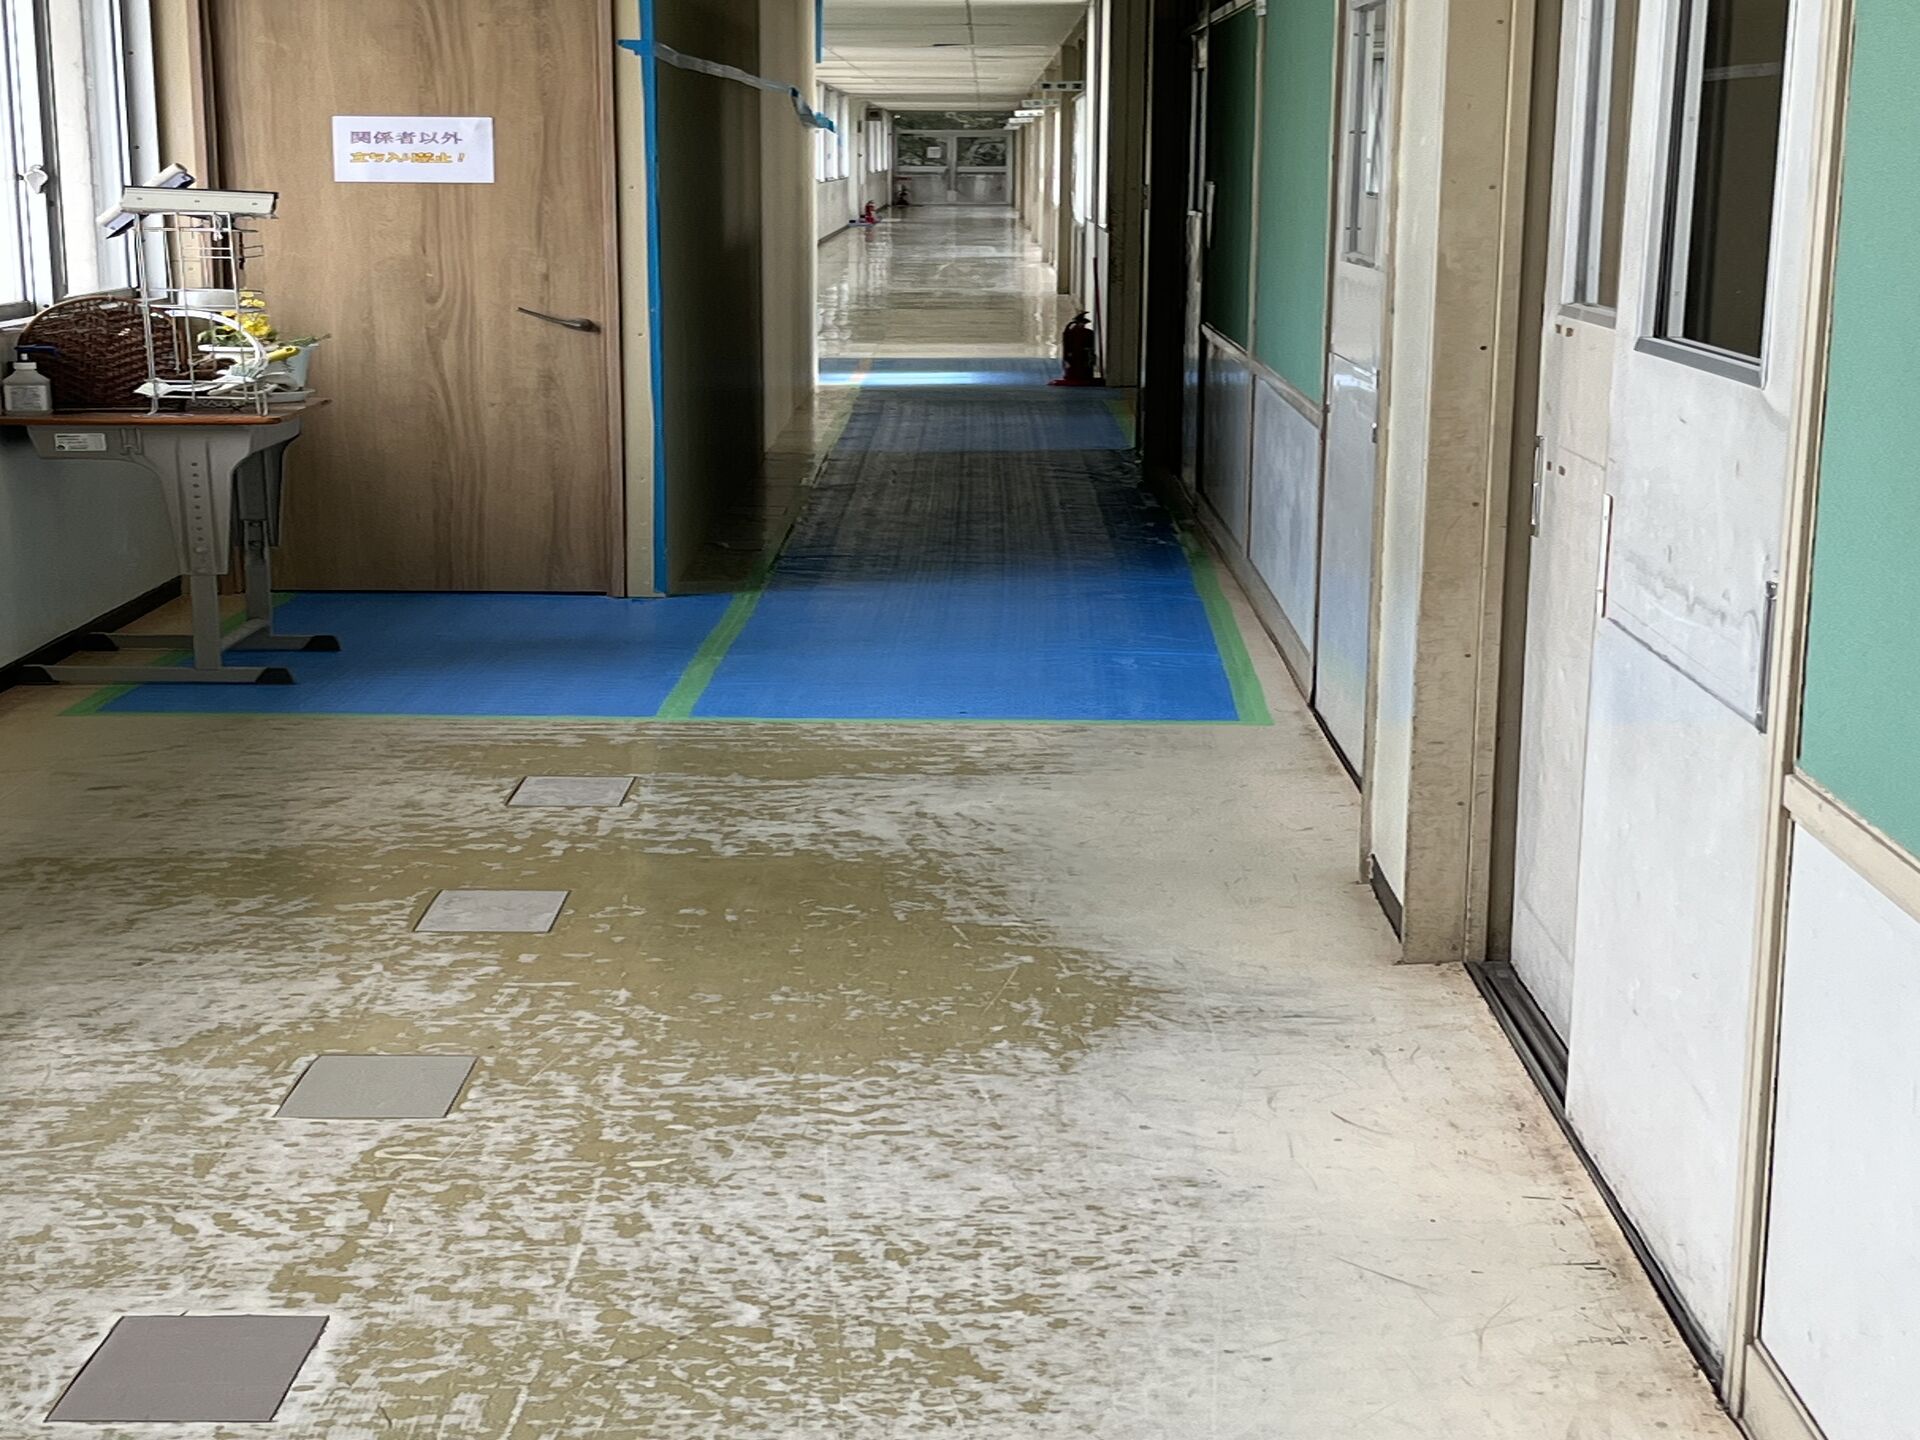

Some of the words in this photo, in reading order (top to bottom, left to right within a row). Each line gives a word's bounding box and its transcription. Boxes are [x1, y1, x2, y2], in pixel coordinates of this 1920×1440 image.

[350, 131, 463, 144] 関係者以外
